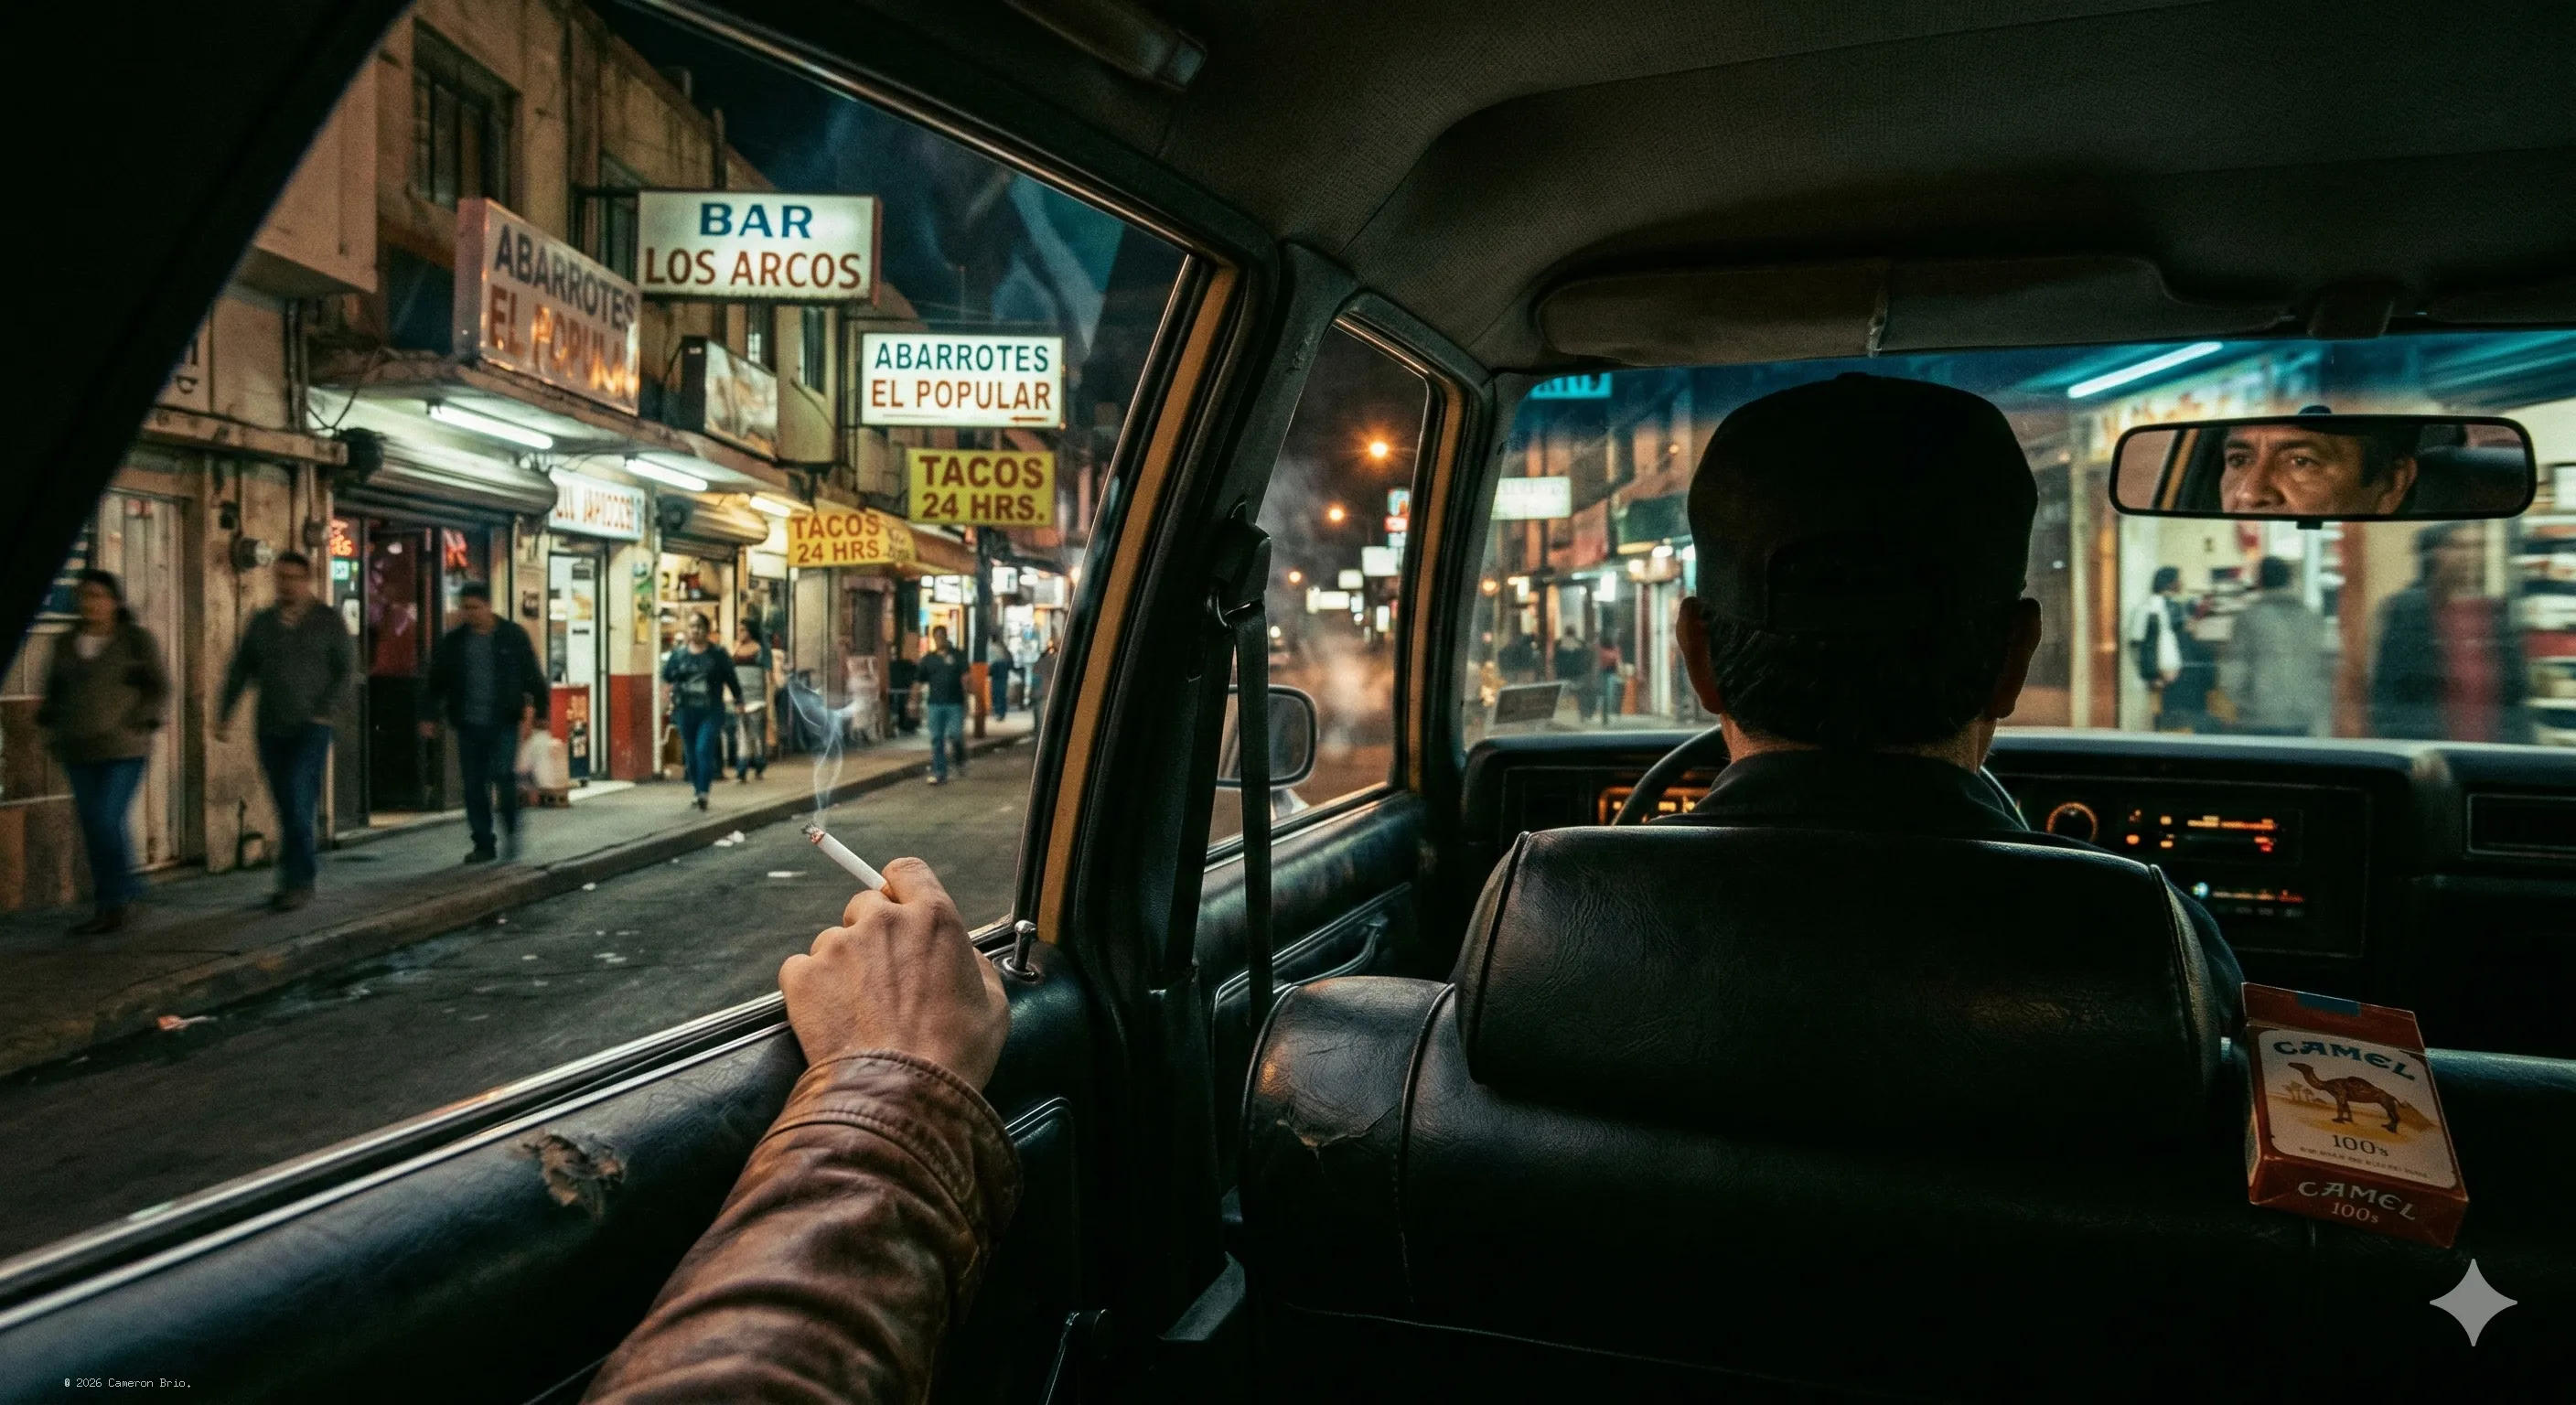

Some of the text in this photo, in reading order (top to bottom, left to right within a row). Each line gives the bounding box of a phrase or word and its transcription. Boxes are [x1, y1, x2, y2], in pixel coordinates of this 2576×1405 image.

[700, 202, 813, 240] BAR
[494, 223, 636, 332] ABARROTES
[645, 247, 862, 290] LOS ARCOS
[488, 284, 524, 356] EL
[875, 342, 1050, 373] ABARROTES
[871, 379, 1051, 412] EL POPULAR
[918, 455, 1045, 489] TACOS
[922, 493, 1045, 521] 24 HRS.
[790, 513, 882, 540] TACOS
[798, 542, 824, 564] 24
[2273, 1040, 2417, 1082] CAMEL
[2298, 1180, 2417, 1222] CAMEL
